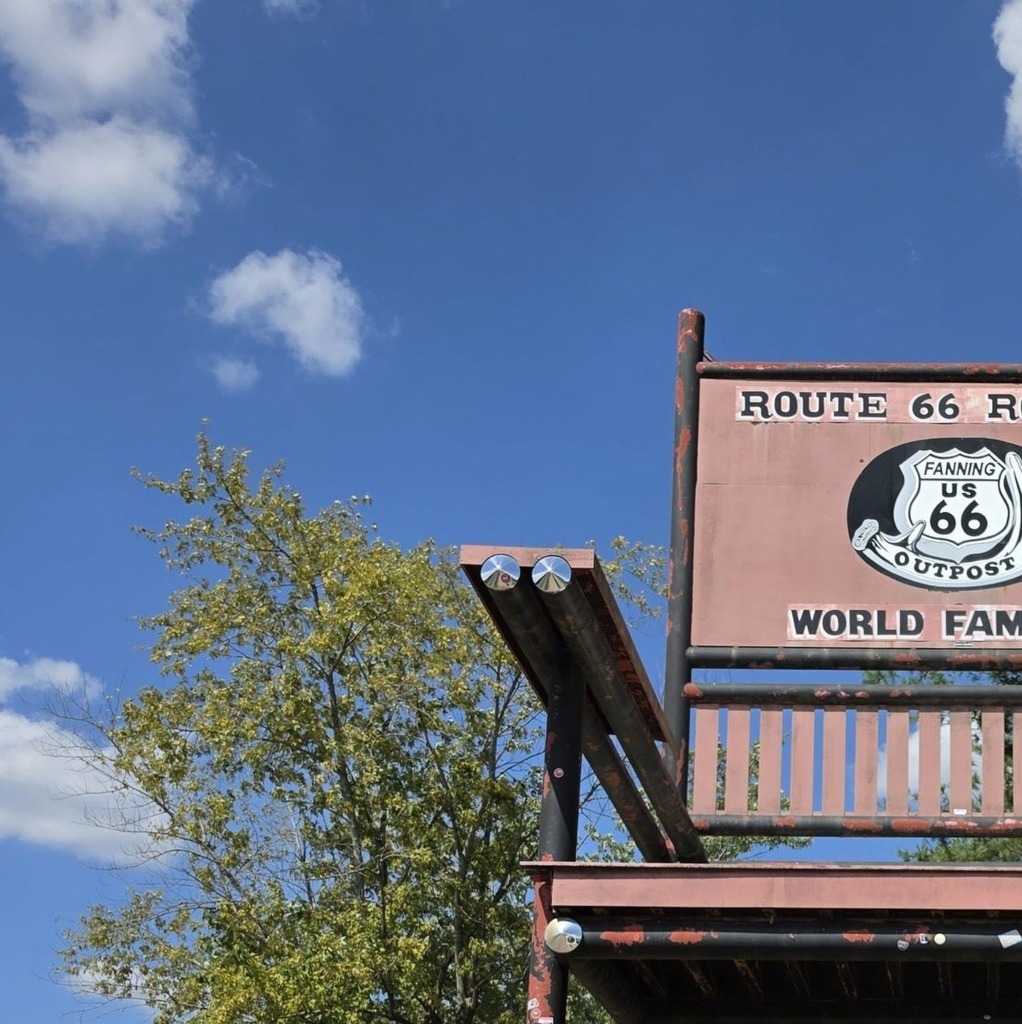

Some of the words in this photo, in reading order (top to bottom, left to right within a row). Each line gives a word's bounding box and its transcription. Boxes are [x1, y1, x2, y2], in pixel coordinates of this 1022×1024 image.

[741, 391, 887, 419] ROUTE
[912, 393, 960, 420] 66
[923, 461, 996, 477] FANNING
[941, 483, 977, 499] US
[929, 500, 988, 537] 66
[894, 551, 1016, 580] OUTPOST
[791, 609, 924, 636] WORLD
